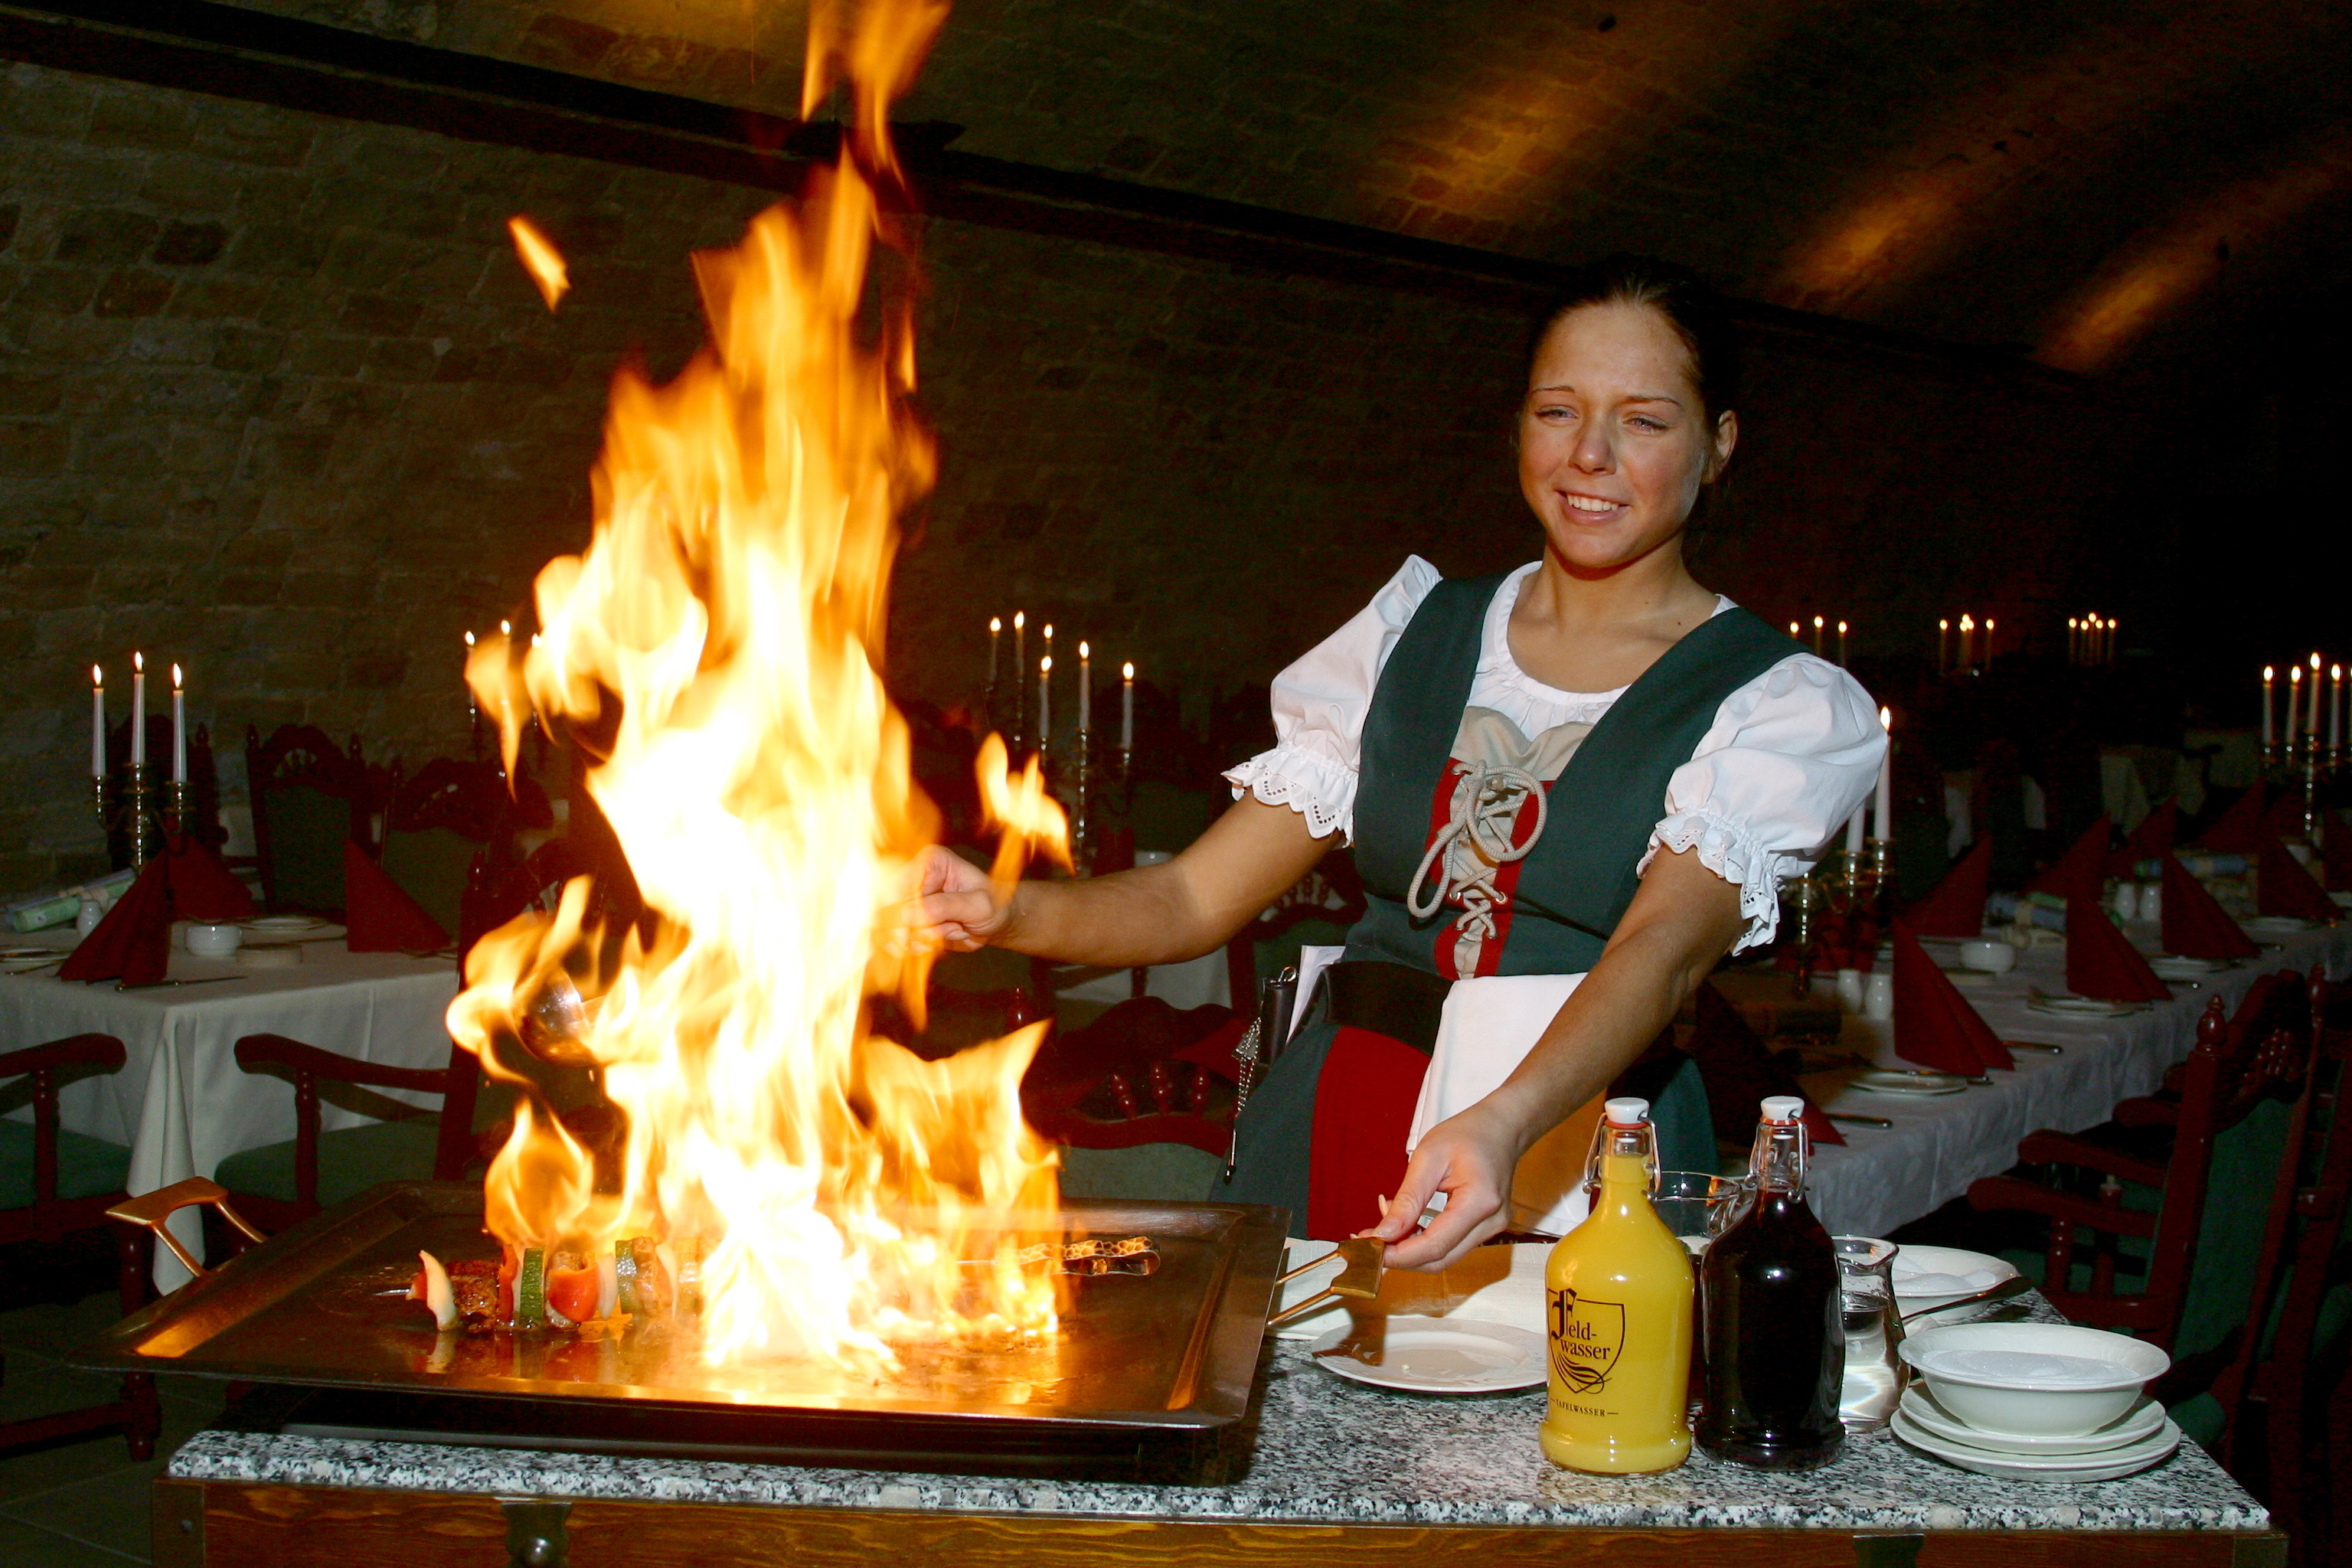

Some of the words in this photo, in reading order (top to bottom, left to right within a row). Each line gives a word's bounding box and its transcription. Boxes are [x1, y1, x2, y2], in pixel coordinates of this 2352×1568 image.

[1551, 1288, 1597, 1341] Feld-
[1560, 1339, 1611, 1360] wasser
[1556, 1398, 1606, 1416] TAFELWASSER
